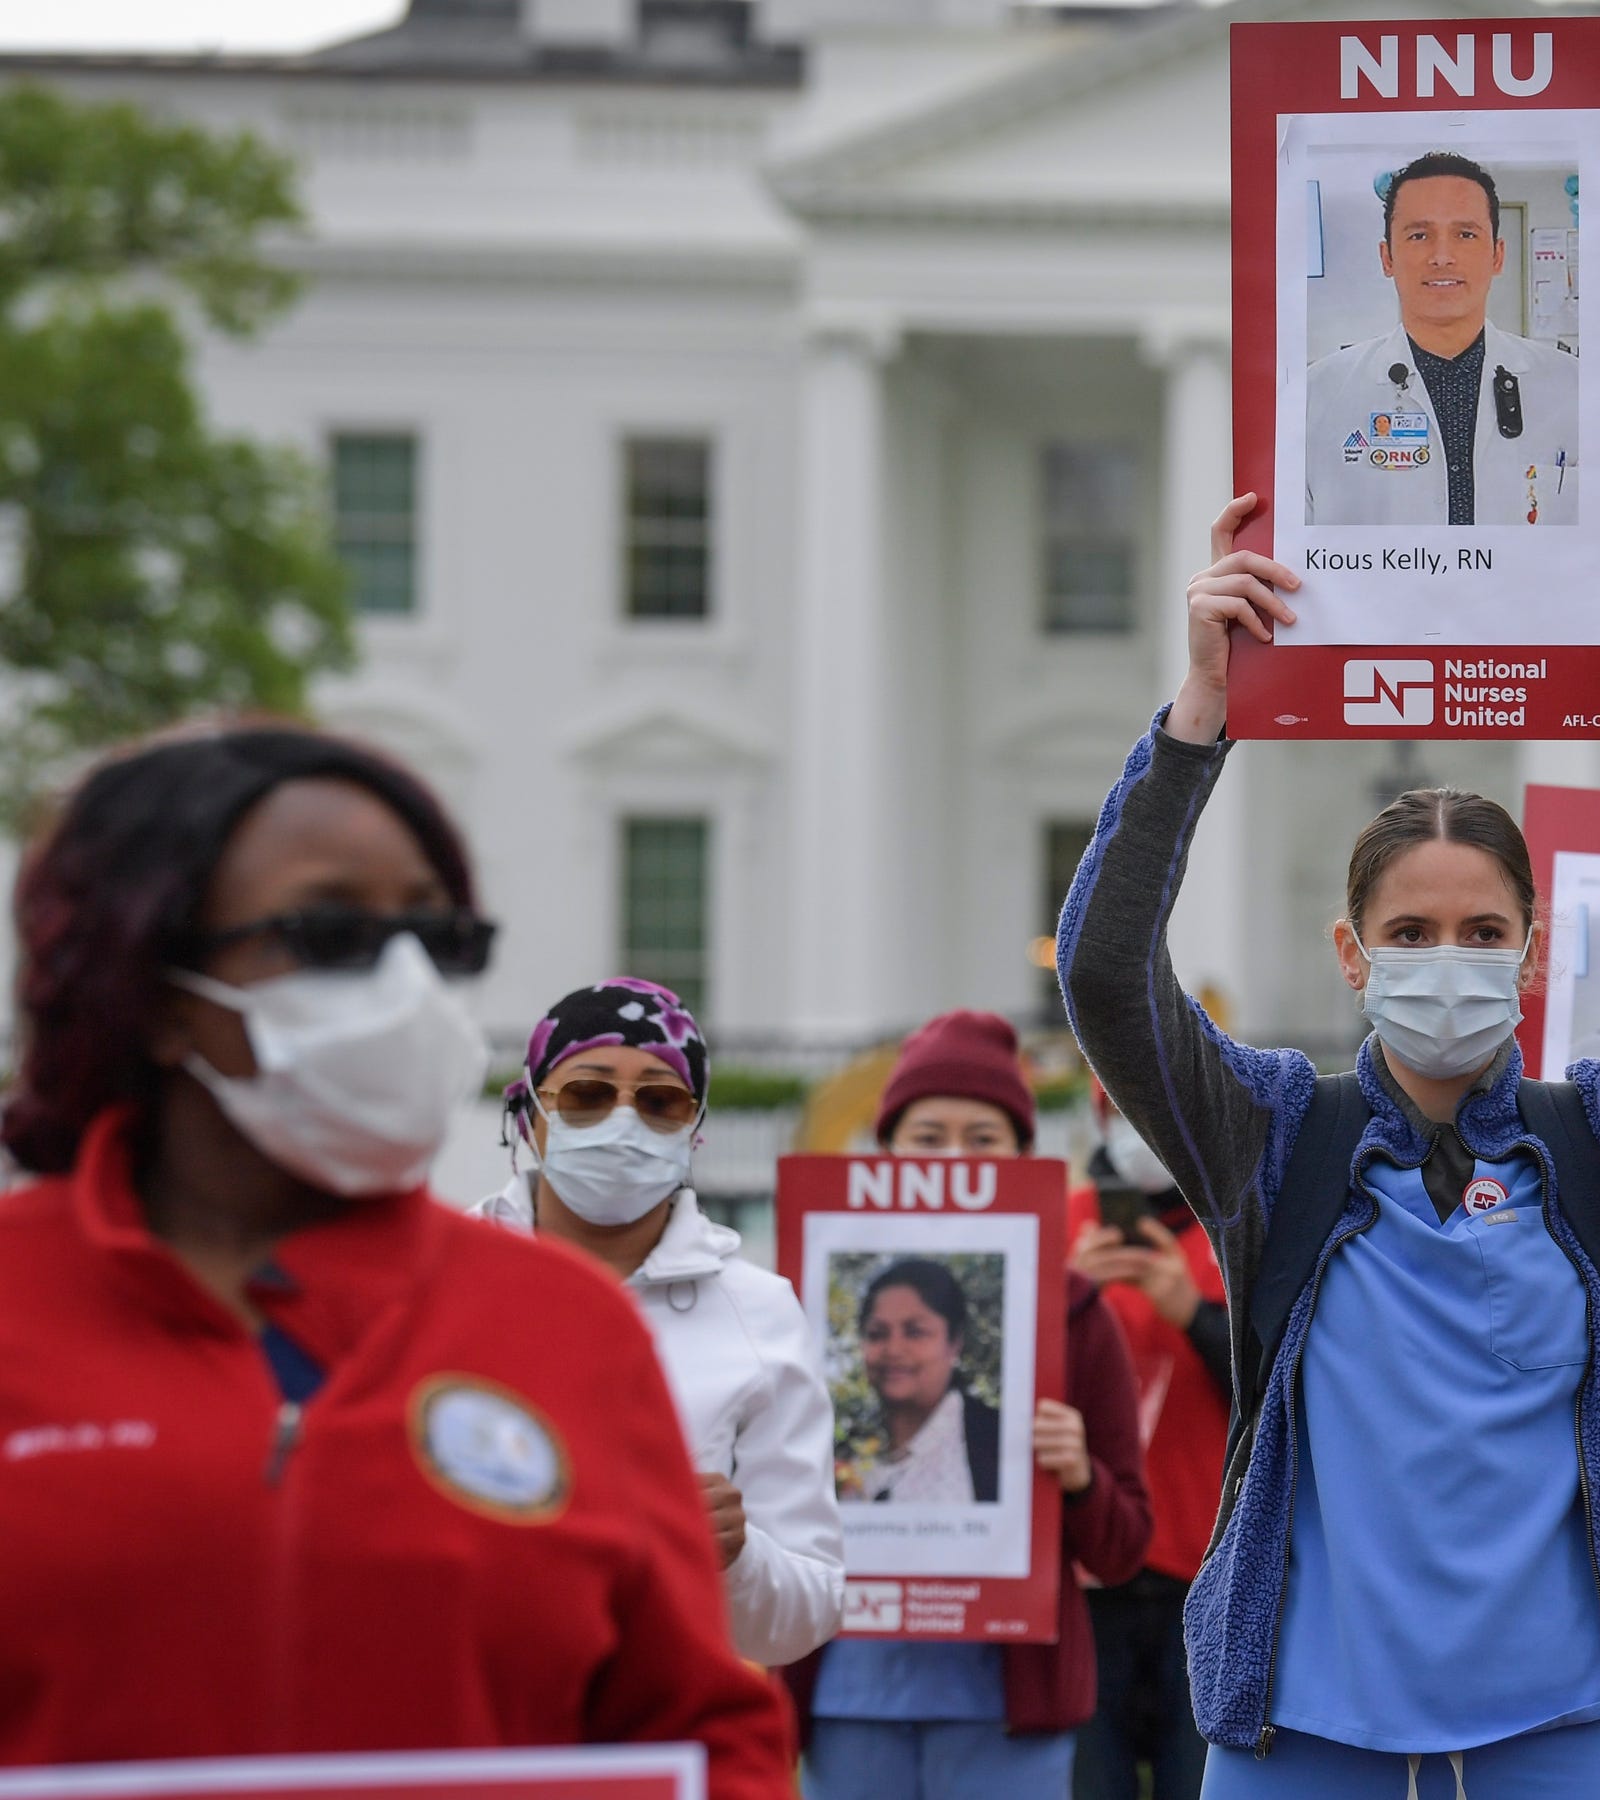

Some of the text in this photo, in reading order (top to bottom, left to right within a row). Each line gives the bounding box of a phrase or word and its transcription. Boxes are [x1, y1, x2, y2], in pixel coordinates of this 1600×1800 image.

[1340, 32, 1554, 99] NNU
[1389, 451, 1411, 462] RN
[1305, 547, 1493, 575] Kious Kelly, RN
[1444, 658, 1547, 679] National
[1444, 683, 1527, 703] Nurses
[1444, 706, 1526, 727] United
[849, 1161, 997, 1210] NNU
